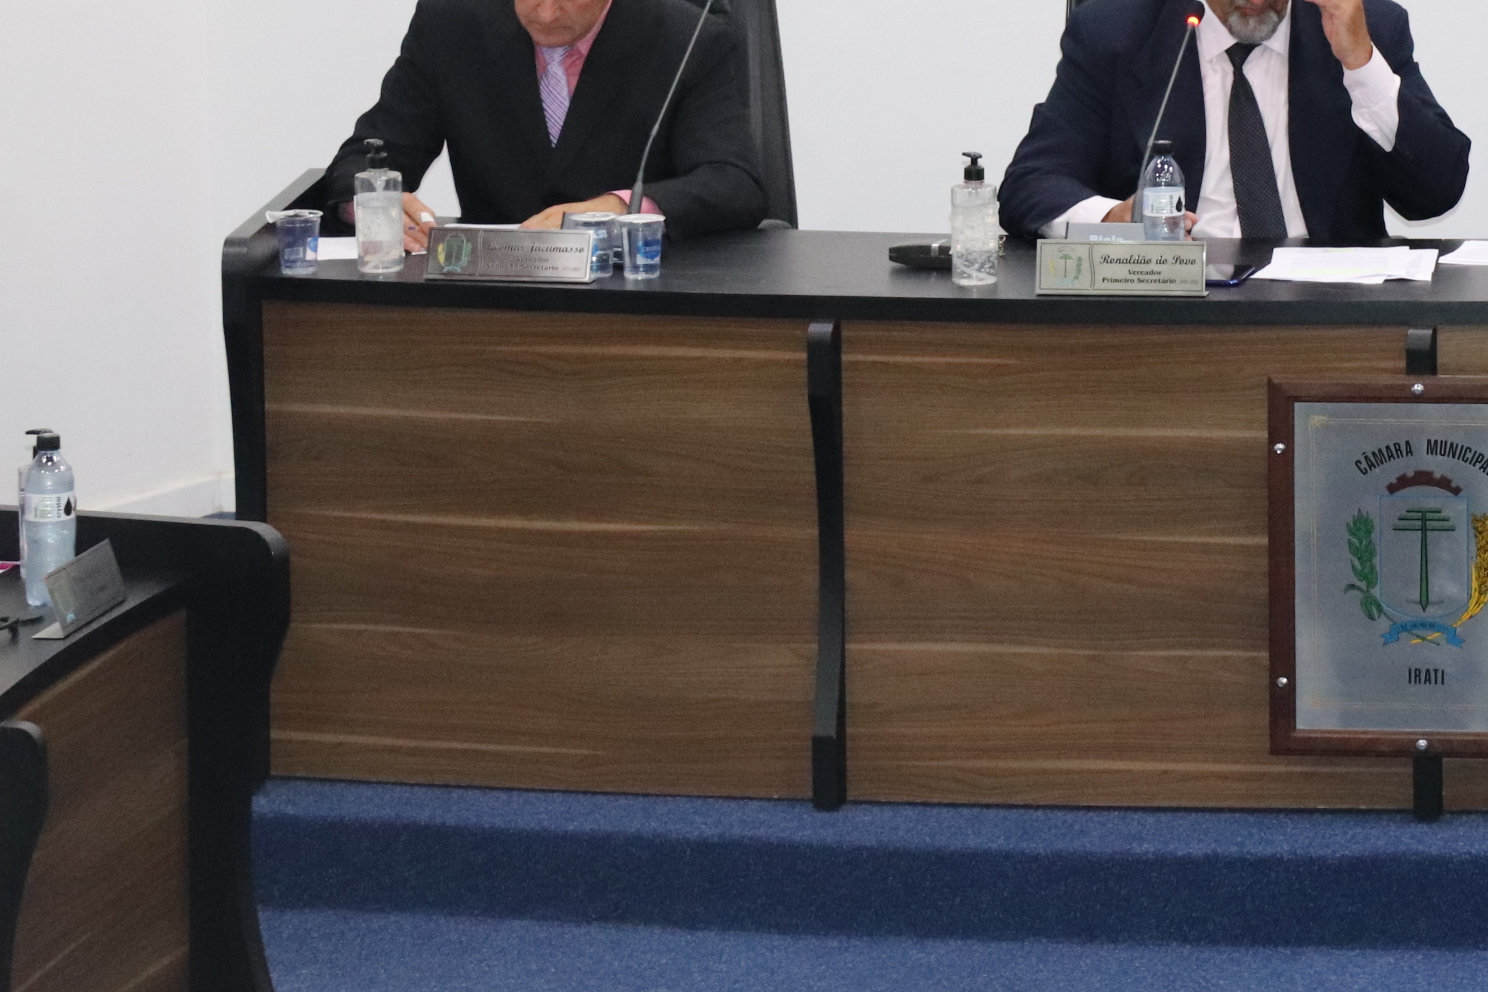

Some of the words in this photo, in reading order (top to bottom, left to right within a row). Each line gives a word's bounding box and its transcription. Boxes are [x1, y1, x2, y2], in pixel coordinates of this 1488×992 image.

[1099, 254, 1153, 265] Ronaldão
[1171, 254, 1196, 265] Povo
[1408, 667, 1445, 685] IRATI
